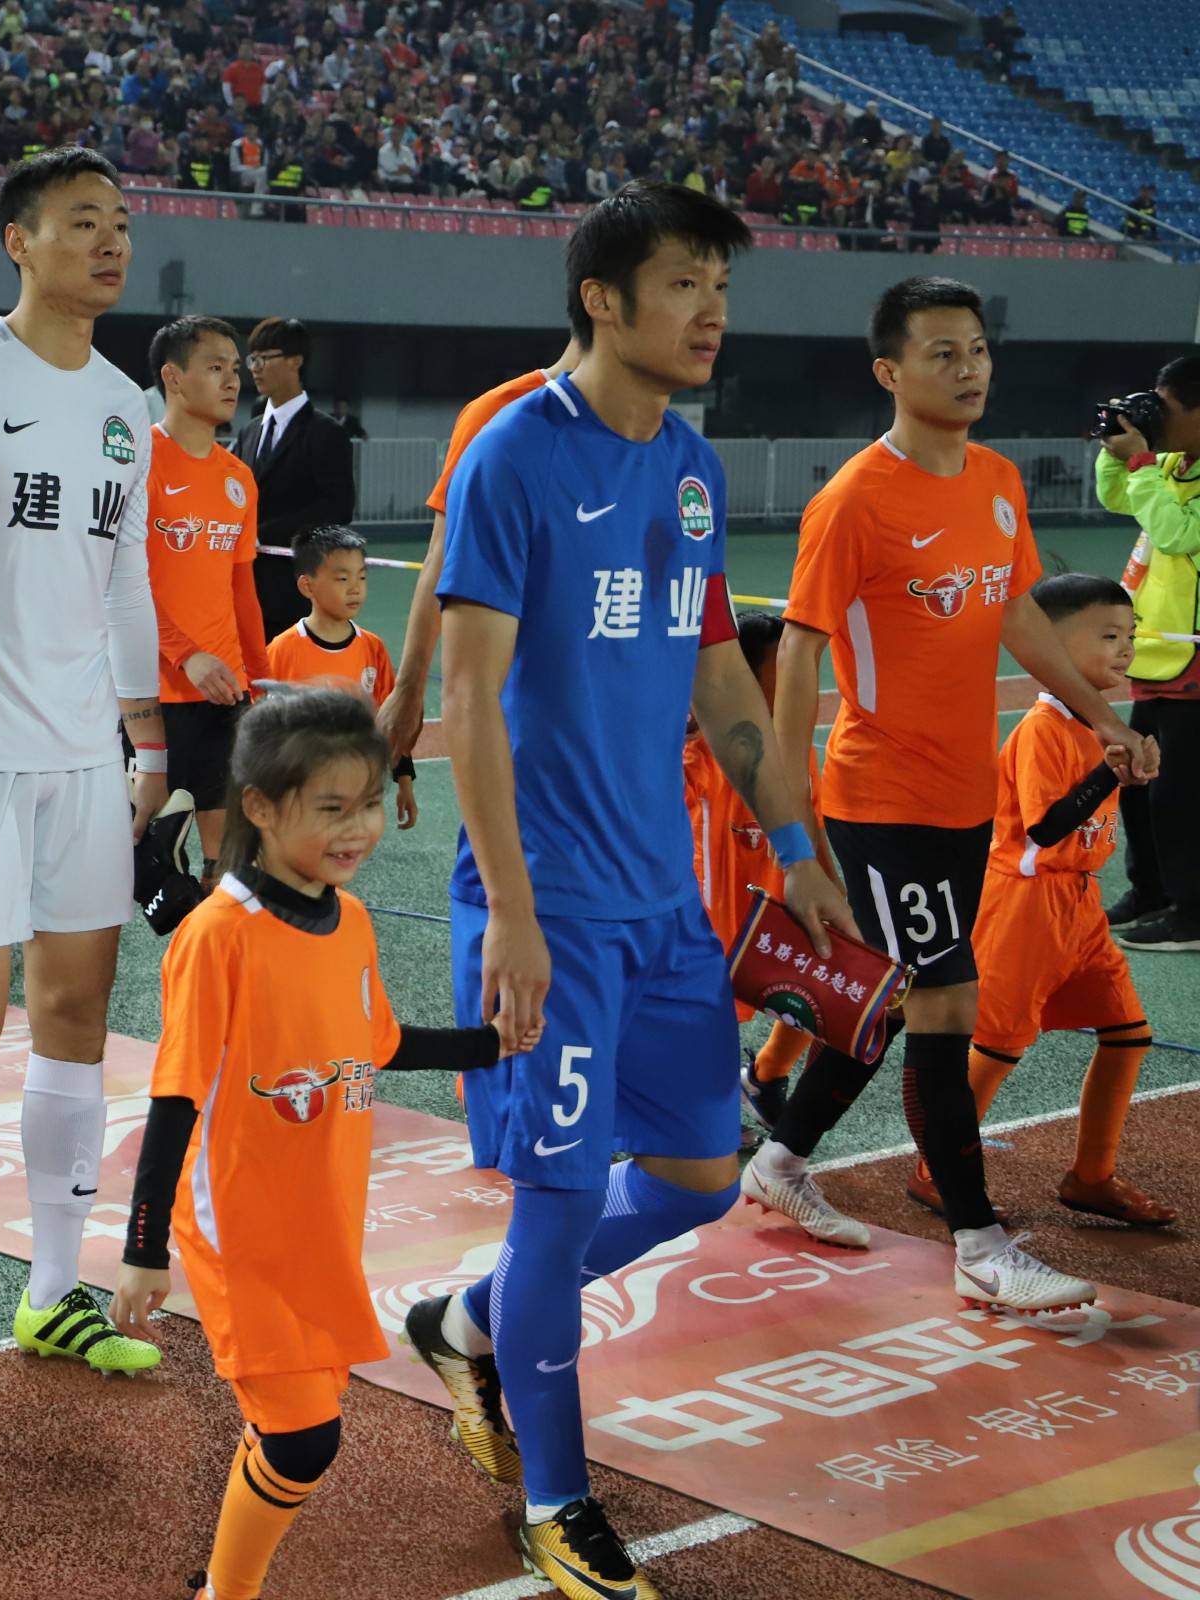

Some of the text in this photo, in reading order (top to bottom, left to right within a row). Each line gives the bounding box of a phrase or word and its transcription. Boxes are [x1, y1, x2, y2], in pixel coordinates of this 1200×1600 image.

[7, 471, 126, 541] 建业
[587, 566, 708, 639] 建业
[900, 879, 960, 943] 31
[551, 1045, 593, 1128] 5
[688, 1251, 893, 1305] CSL
